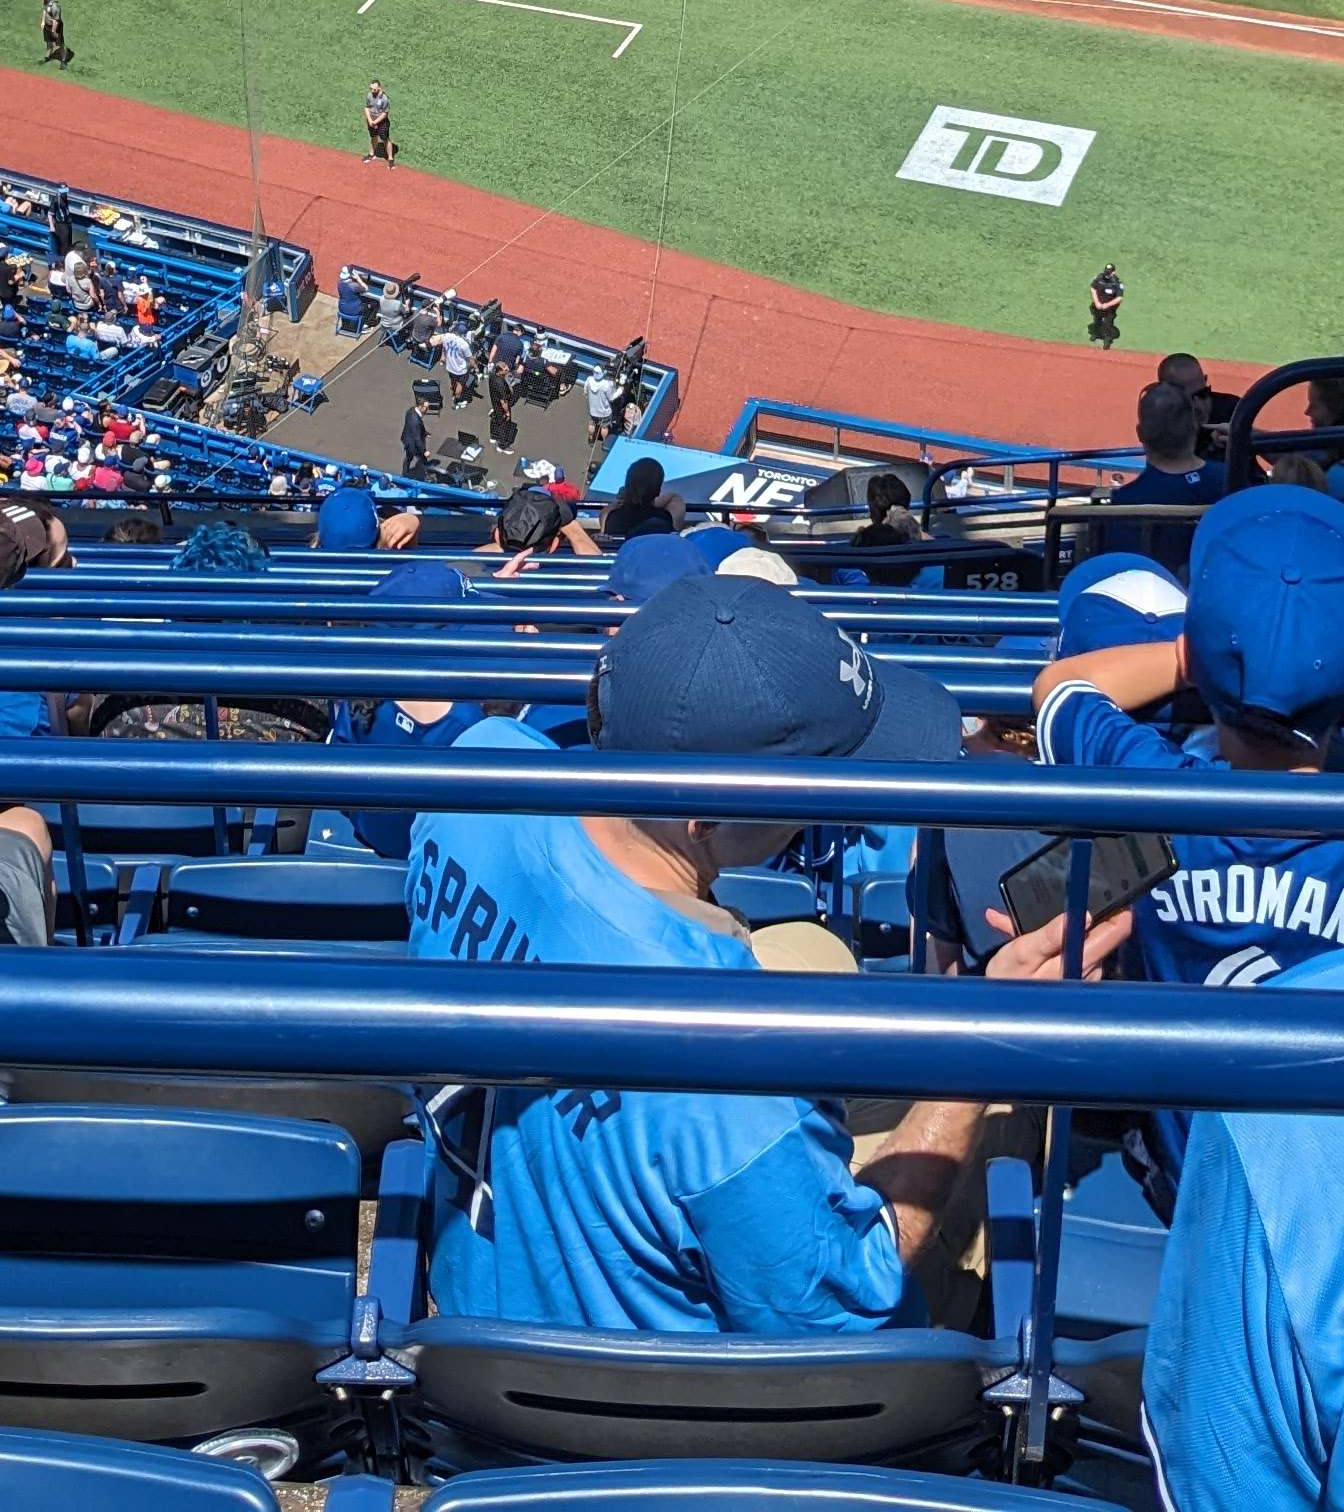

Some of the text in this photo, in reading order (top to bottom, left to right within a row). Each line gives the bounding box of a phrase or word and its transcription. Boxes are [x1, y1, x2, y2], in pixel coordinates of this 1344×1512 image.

[942, 121, 1063, 183] TD
[758, 468, 819, 488] TORONTO
[967, 571, 1019, 591] 528
[416, 838, 542, 963] SPRI
